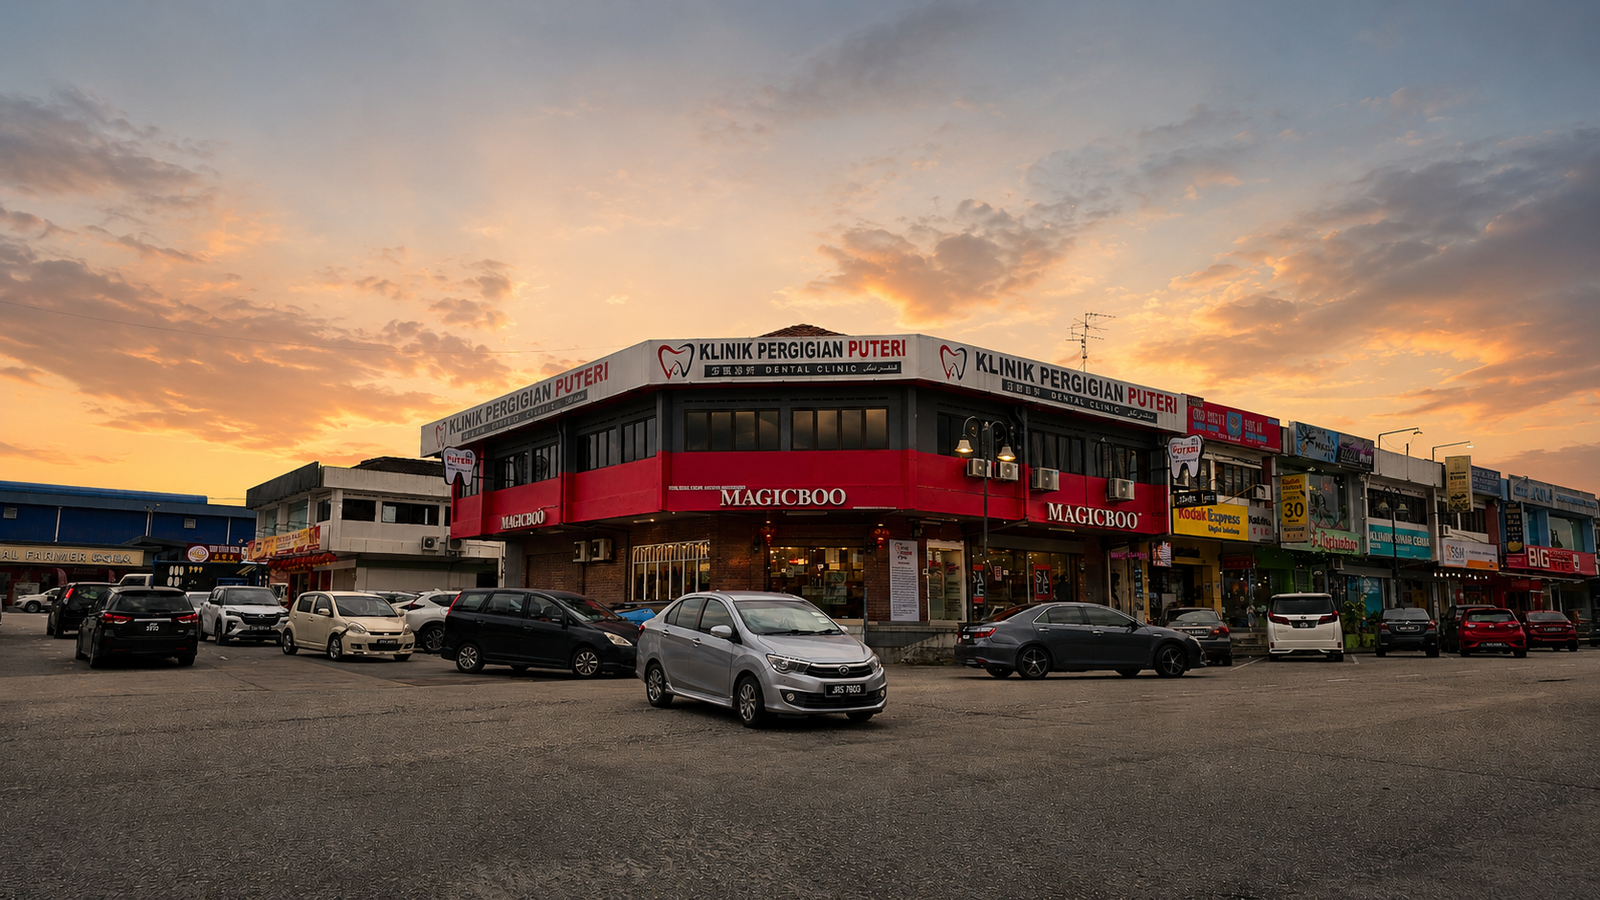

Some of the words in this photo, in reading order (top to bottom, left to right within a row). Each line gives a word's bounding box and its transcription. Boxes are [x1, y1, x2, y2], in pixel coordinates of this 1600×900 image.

[700, 342, 754, 360] KLINIK
[757, 340, 843, 359] PERGIGIAN
[848, 339, 906, 357] PUTERI
[765, 365, 810, 374] DENTAL
[816, 364, 857, 373] CLINIC
[975, 351, 1034, 382] KLINIK
[1039, 366, 1124, 403] PERGIGIAN
[1127, 386, 1178, 414] PUTERI
[449, 408, 483, 436] KLINIK
[485, 382, 552, 423] PERGIGIAN
[555, 361, 609, 398] PUTERI
[1051, 391, 1085, 406] DENTAL
[1089, 401, 1120, 414] CLINIC
[719, 487, 847, 507] MAGICBOO
[500, 509, 545, 530] MAGICBOO
[1046, 502, 1139, 530] MAGICBOO
[1178, 507, 1207, 521] Kodak
[1207, 508, 1241, 526] Express
[1284, 502, 1304, 518] 30
[26, 550, 87, 562] FARMER
[1528, 547, 1550, 568] BIG
